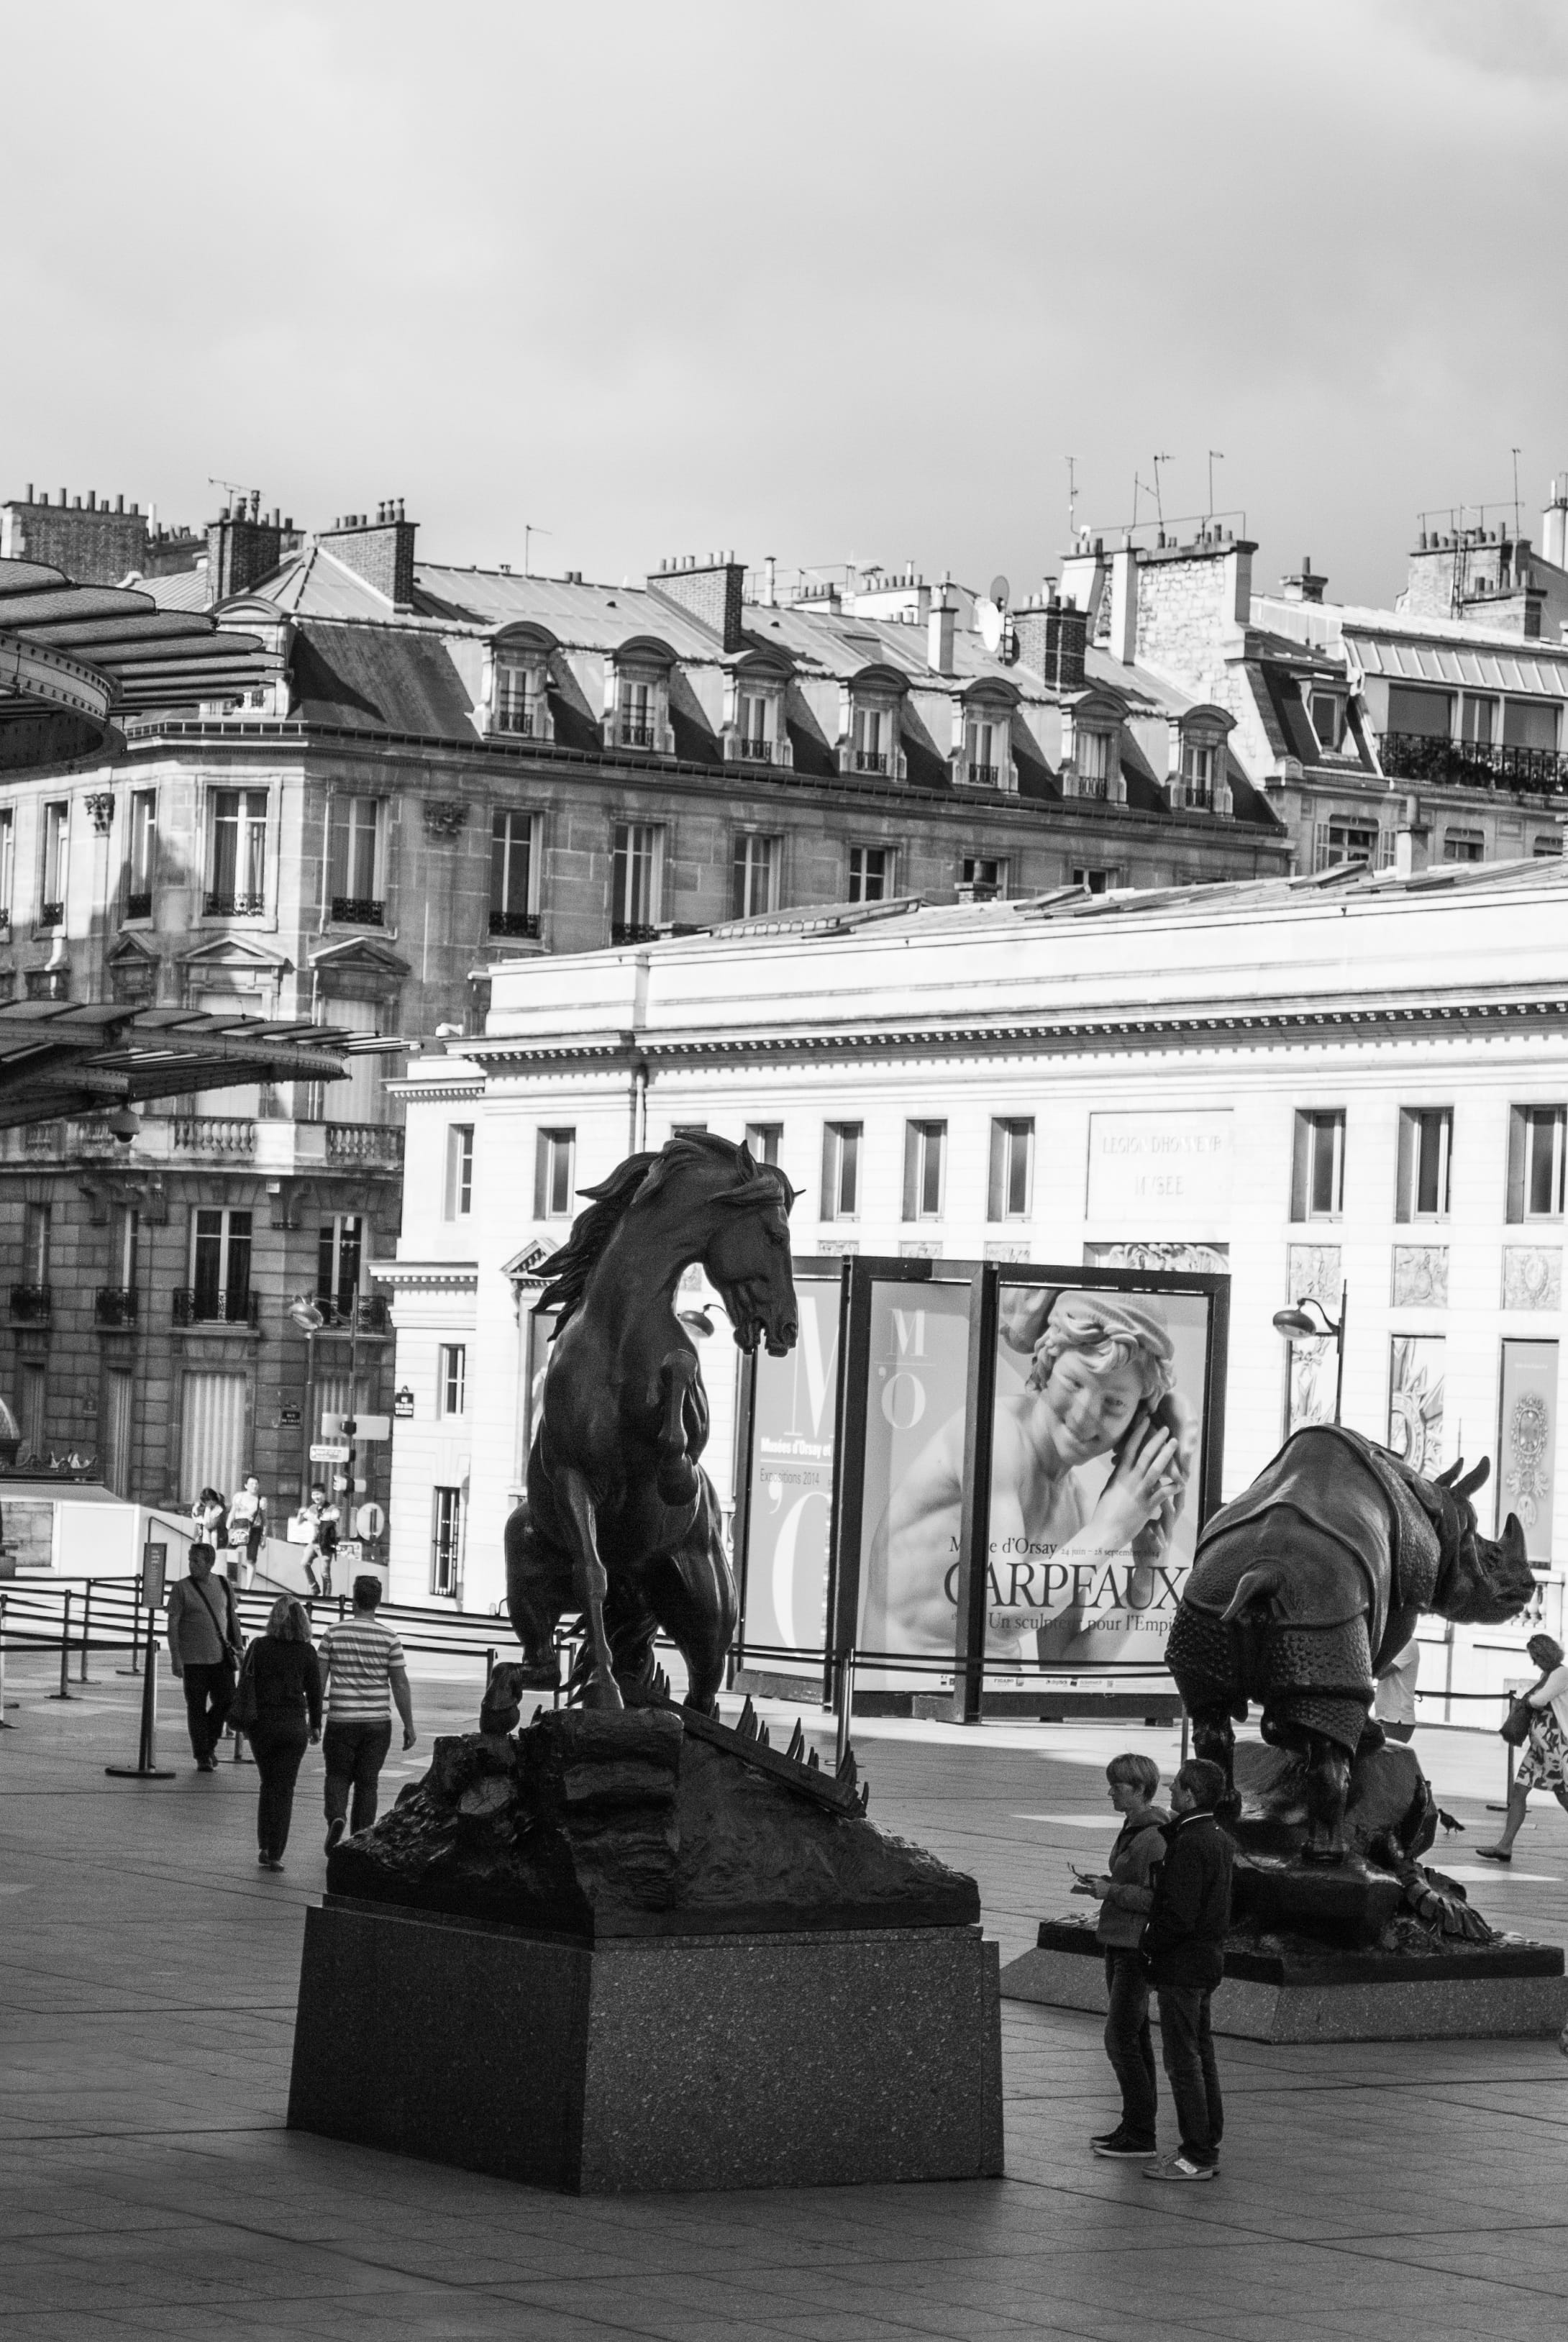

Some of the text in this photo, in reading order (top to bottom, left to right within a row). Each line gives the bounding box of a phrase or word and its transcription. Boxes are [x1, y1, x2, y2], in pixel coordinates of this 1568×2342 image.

[886, 1308, 929, 1357] M
[760, 1437, 831, 1460] Musées d'Orsay et
[760, 1467, 820, 1485] Expositions 2014
[1002, 1536, 1059, 1559] d'Orsay
[1071, 1548, 1086, 1557] juin
[988, 1612, 1011, 1629] Un
[1086, 1618, 1121, 1636] pour
[1126, 1615, 1172, 1637] l'Empi
